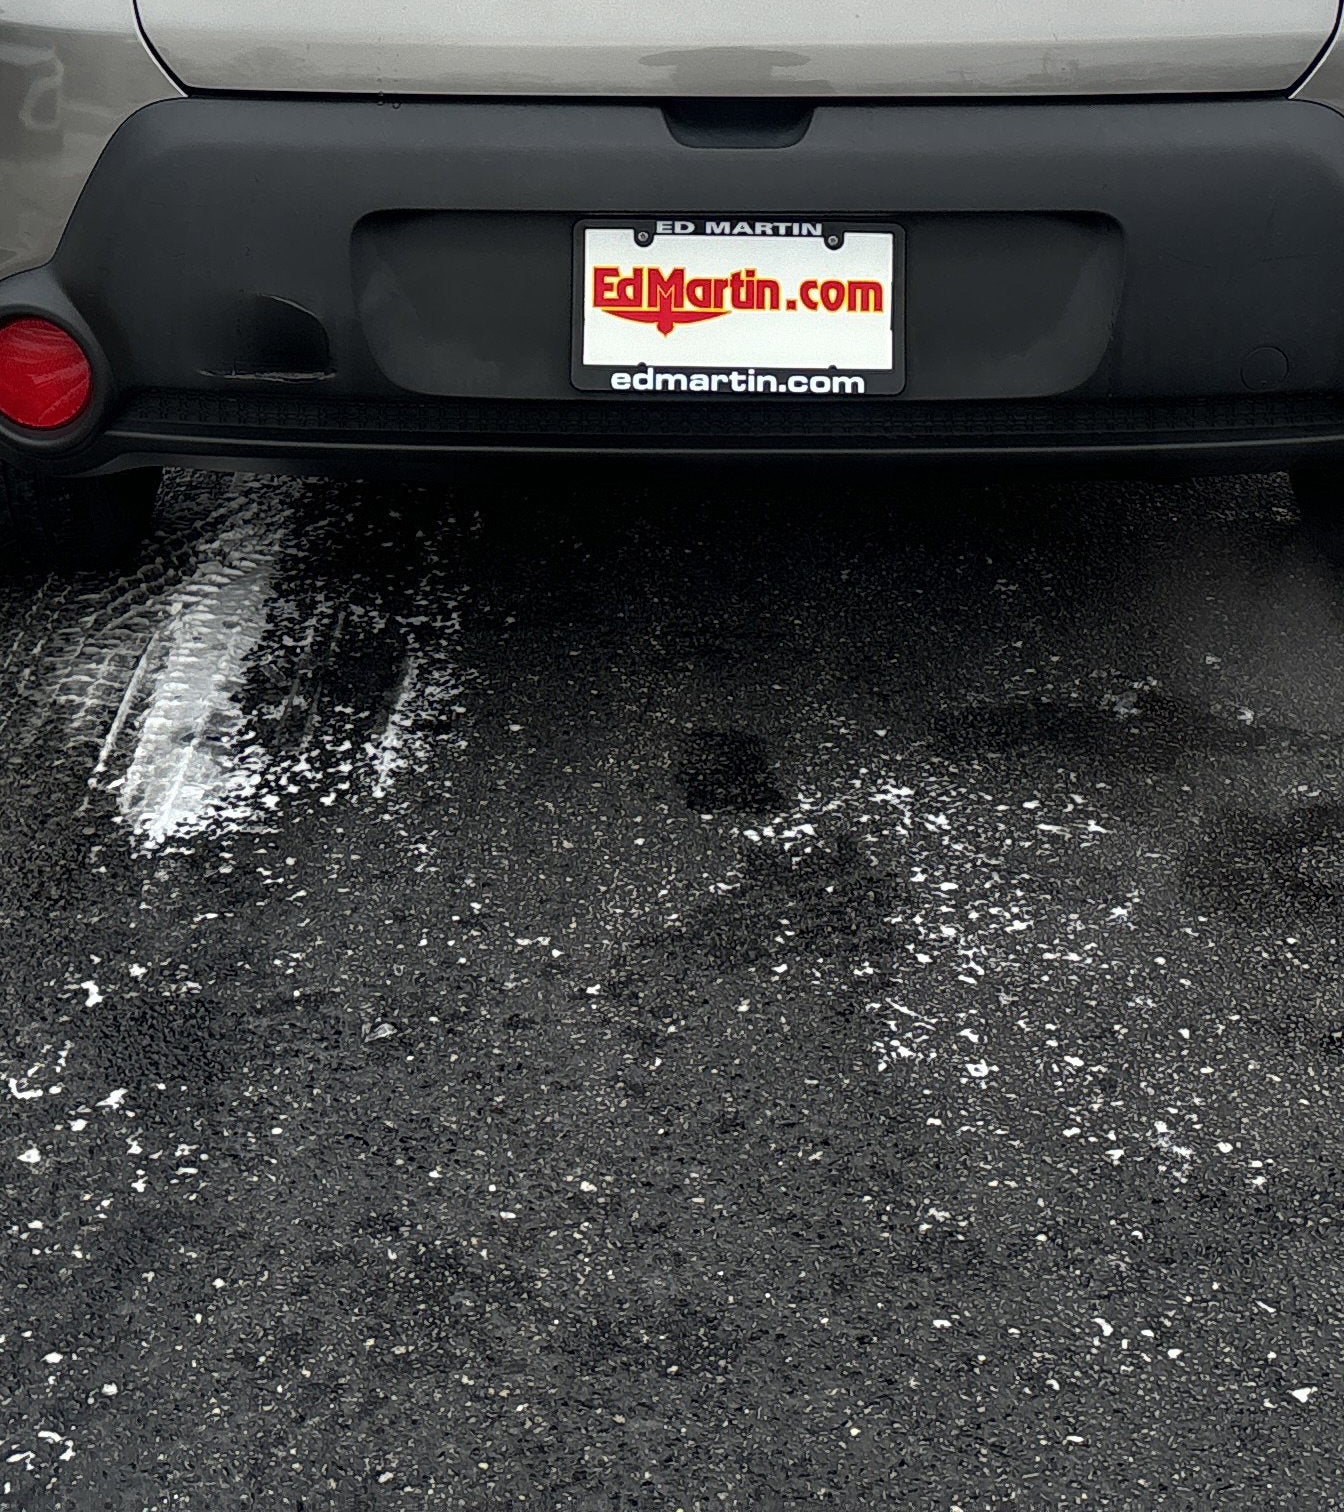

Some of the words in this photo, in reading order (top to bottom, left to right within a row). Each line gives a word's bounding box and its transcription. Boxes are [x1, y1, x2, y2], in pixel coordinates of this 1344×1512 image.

[656, 221, 696, 234] ED
[705, 222, 823, 237] MARTIN
[592, 265, 885, 314] EdMartin.com
[610, 367, 865, 394] edmartin.com
